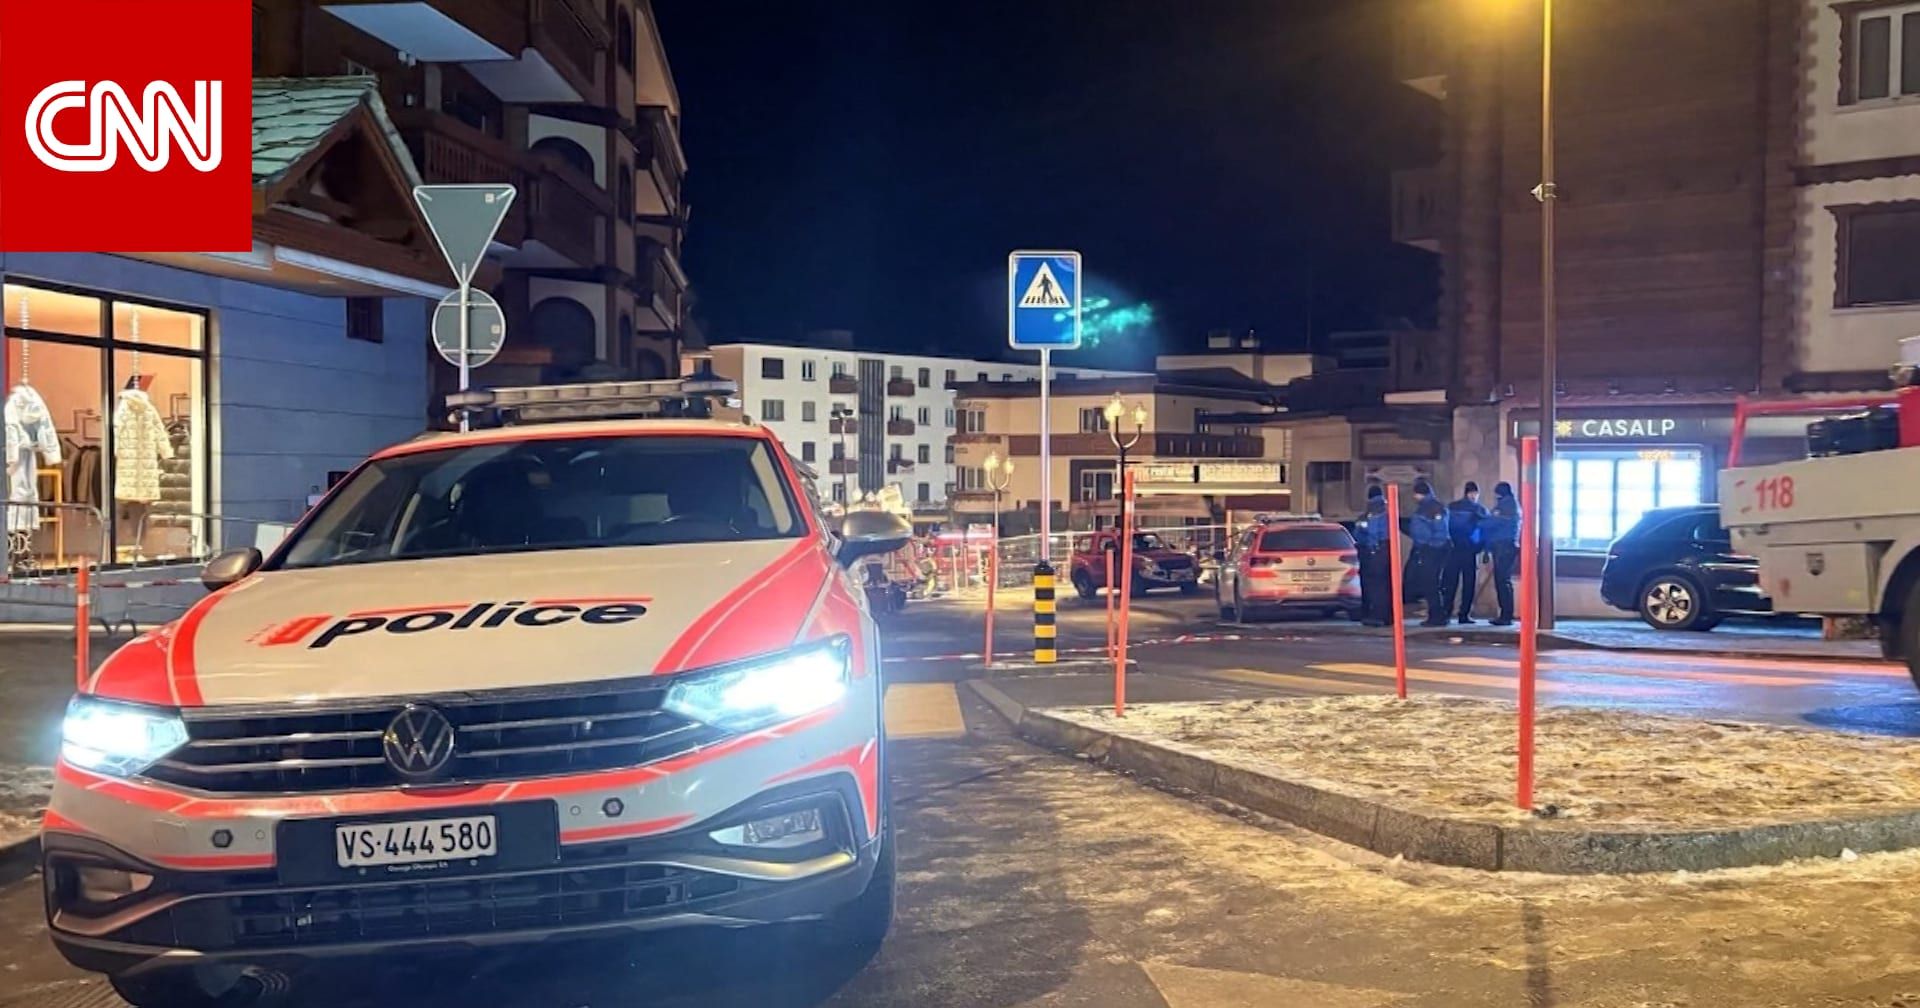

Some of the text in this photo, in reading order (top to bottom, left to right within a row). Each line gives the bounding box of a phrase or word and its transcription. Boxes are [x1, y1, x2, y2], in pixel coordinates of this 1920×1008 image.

[1582, 419, 1676, 436] CASALP
[1755, 475, 1794, 511] 118
[308, 601, 647, 649] police
